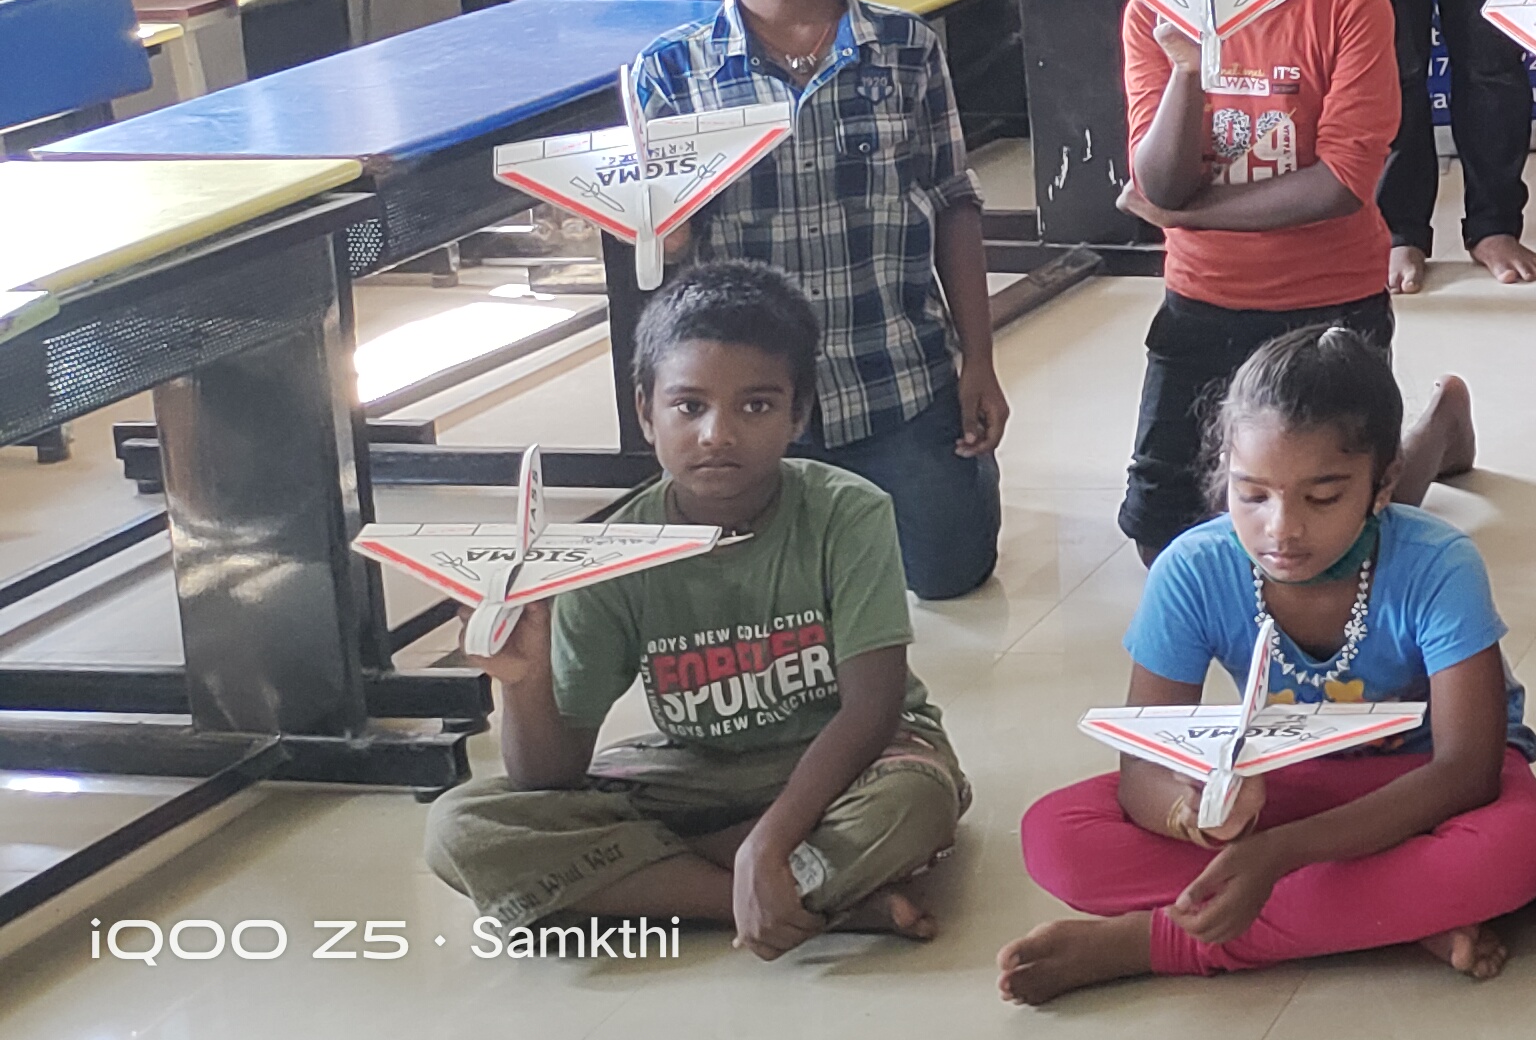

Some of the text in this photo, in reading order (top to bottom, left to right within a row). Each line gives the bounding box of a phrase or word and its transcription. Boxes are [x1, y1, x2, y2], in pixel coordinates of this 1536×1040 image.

[1273, 65, 1301, 80] IT'S
[597, 156, 698, 186] SIGMA
[466, 548, 588, 562] SIGMA
[647, 635, 688, 654] BOYS
[694, 627, 731, 646] NEW
[709, 714, 749, 737] NEW
[1188, 726, 1305, 739] SIGMA
